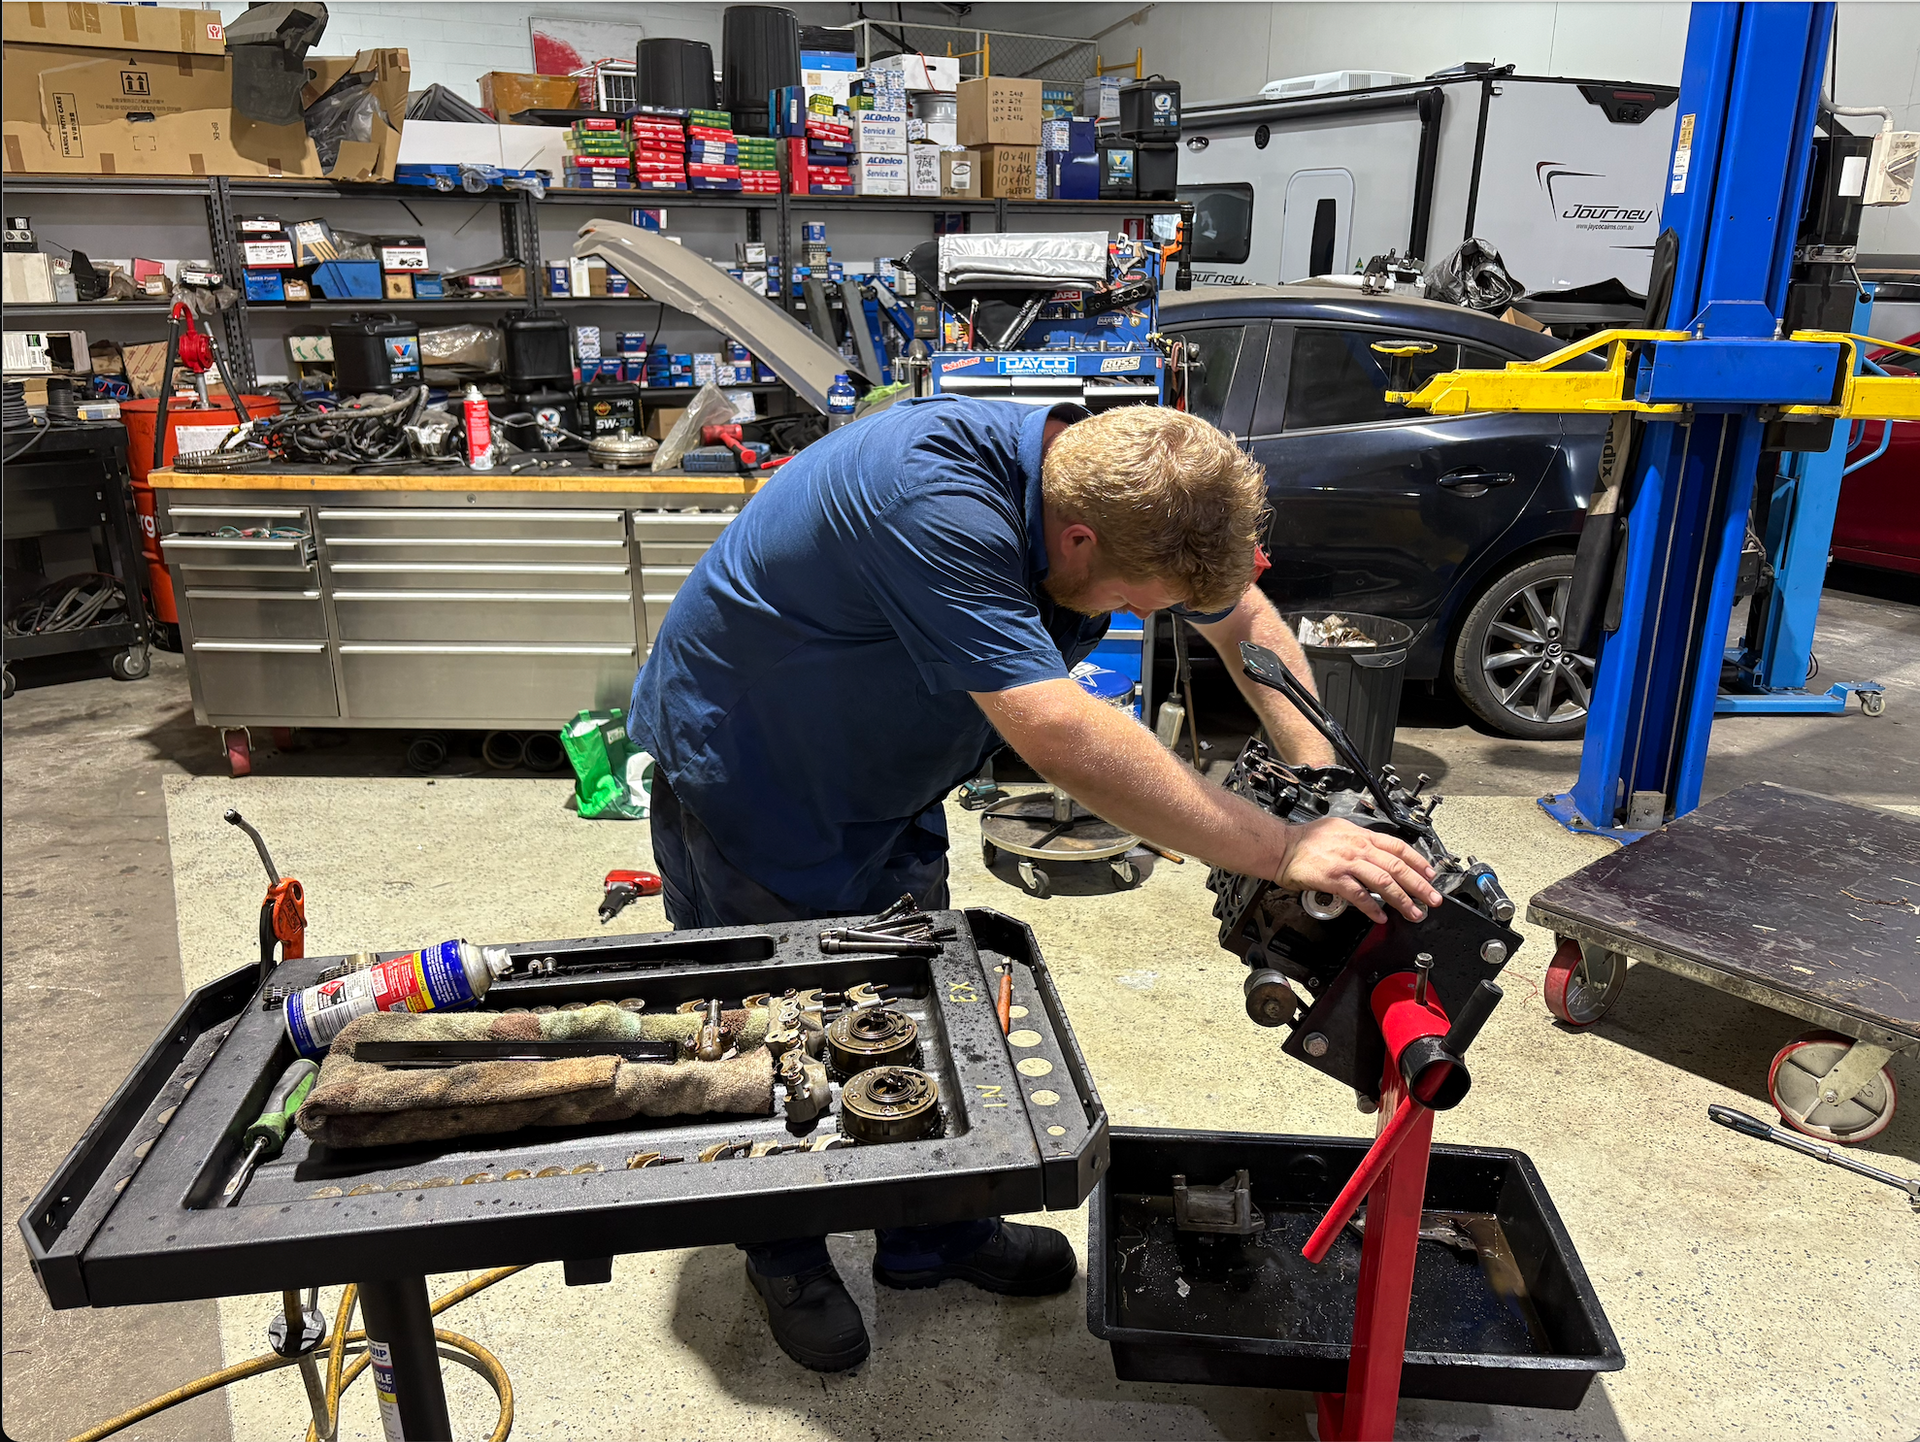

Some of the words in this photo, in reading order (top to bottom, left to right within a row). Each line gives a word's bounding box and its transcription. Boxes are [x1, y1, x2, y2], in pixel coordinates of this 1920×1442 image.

[56, 96, 64, 113] CARE
[863, 113, 901, 122] ACDelco
[863, 126, 885, 135] Service
[887, 127, 896, 135] Kit
[62, 131, 70, 155] HANDLE
[867, 156, 903, 165] ACDelco
[998, 151, 1010, 162] 10
[1017, 150, 1031, 164] 411
[866, 169, 889, 178] Service
[890, 170, 899, 178] Kit
[997, 165, 1008, 175] 10
[997, 176, 1008, 188] 10
[1015, 175, 1030, 187] 418
[1562, 203, 1653, 223] Journey
[1191, 271, 1245, 286] ourney
[942, 357, 981, 373] Nolathane
[1005, 357, 1070, 369] DAYCO
[948, 980, 978, 1003] EX
[976, 1084, 1008, 1108] IN
